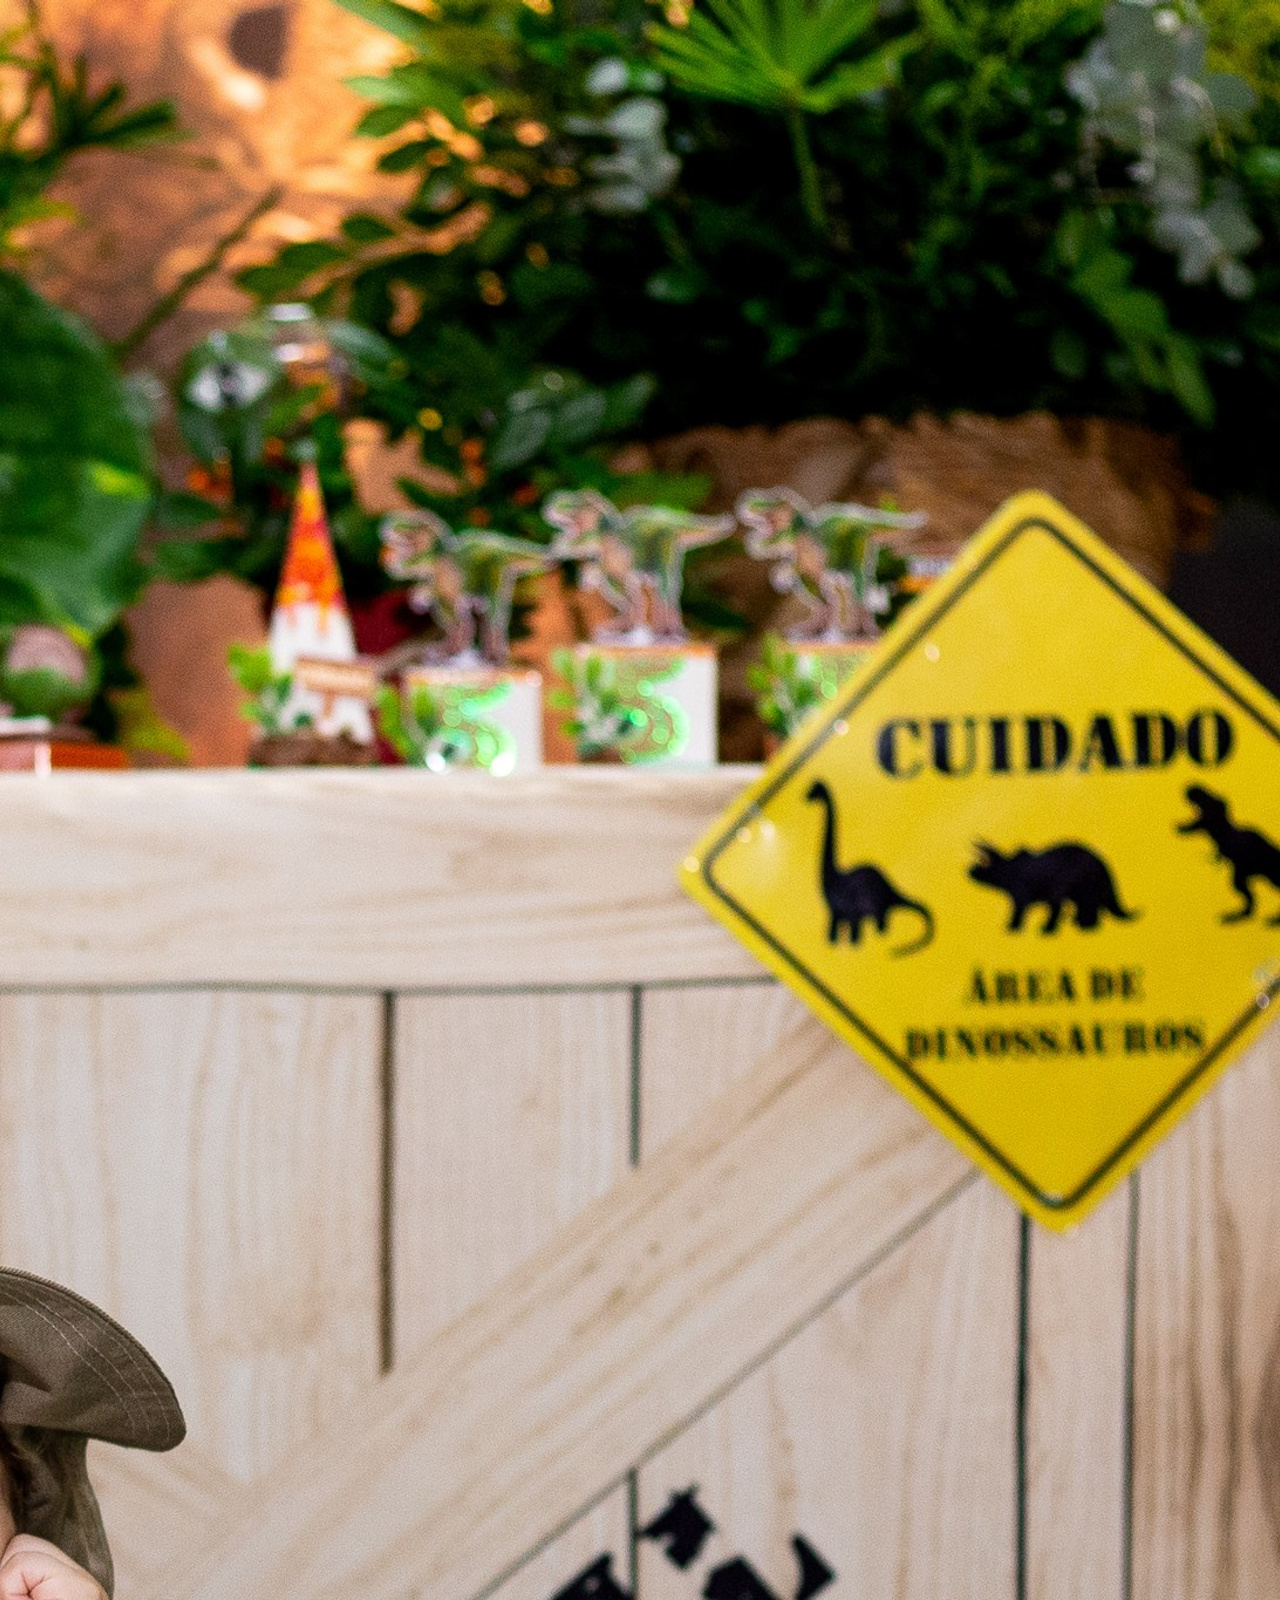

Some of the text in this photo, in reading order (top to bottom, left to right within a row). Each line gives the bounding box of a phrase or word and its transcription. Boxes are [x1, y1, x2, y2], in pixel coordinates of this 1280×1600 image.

[875, 708, 1234, 780] CUIDADO
[1089, 964, 1146, 1000] DE
[904, 1018, 1206, 1061] DINOSSAUROS
